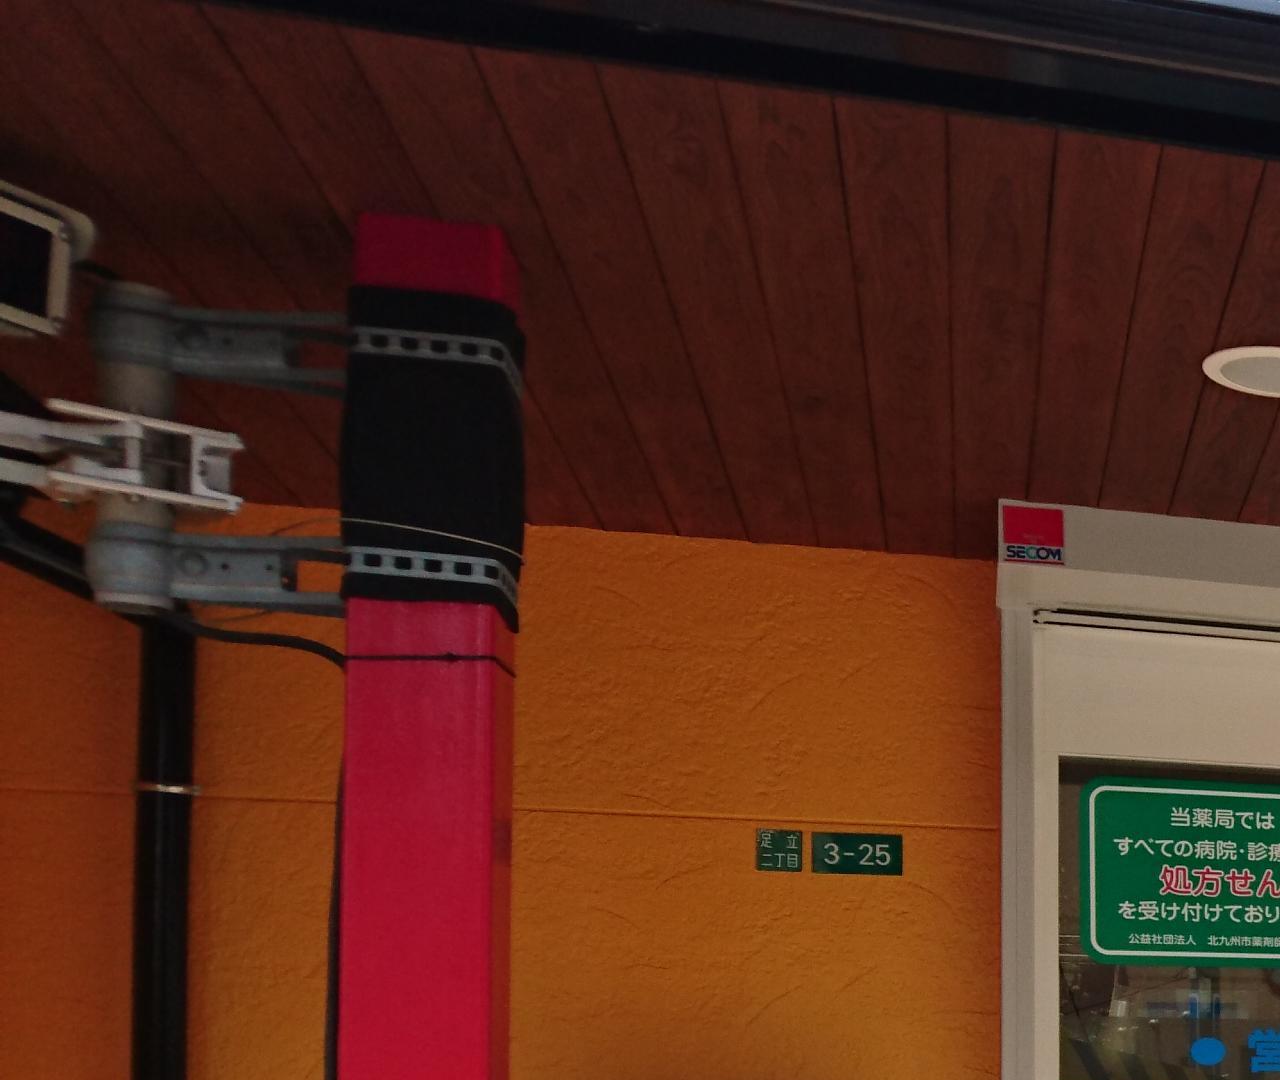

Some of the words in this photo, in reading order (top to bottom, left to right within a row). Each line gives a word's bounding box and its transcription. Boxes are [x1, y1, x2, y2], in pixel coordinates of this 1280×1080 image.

[1006, 545, 1062, 561] SECOM
[1170, 807, 1276, 830] 当薬局では
[760, 833, 799, 849] 足立
[760, 853, 799, 868] 二丁目
[823, 842, 892, 867] 3-25
[1128, 933, 1198, 947] 公益社団法人
